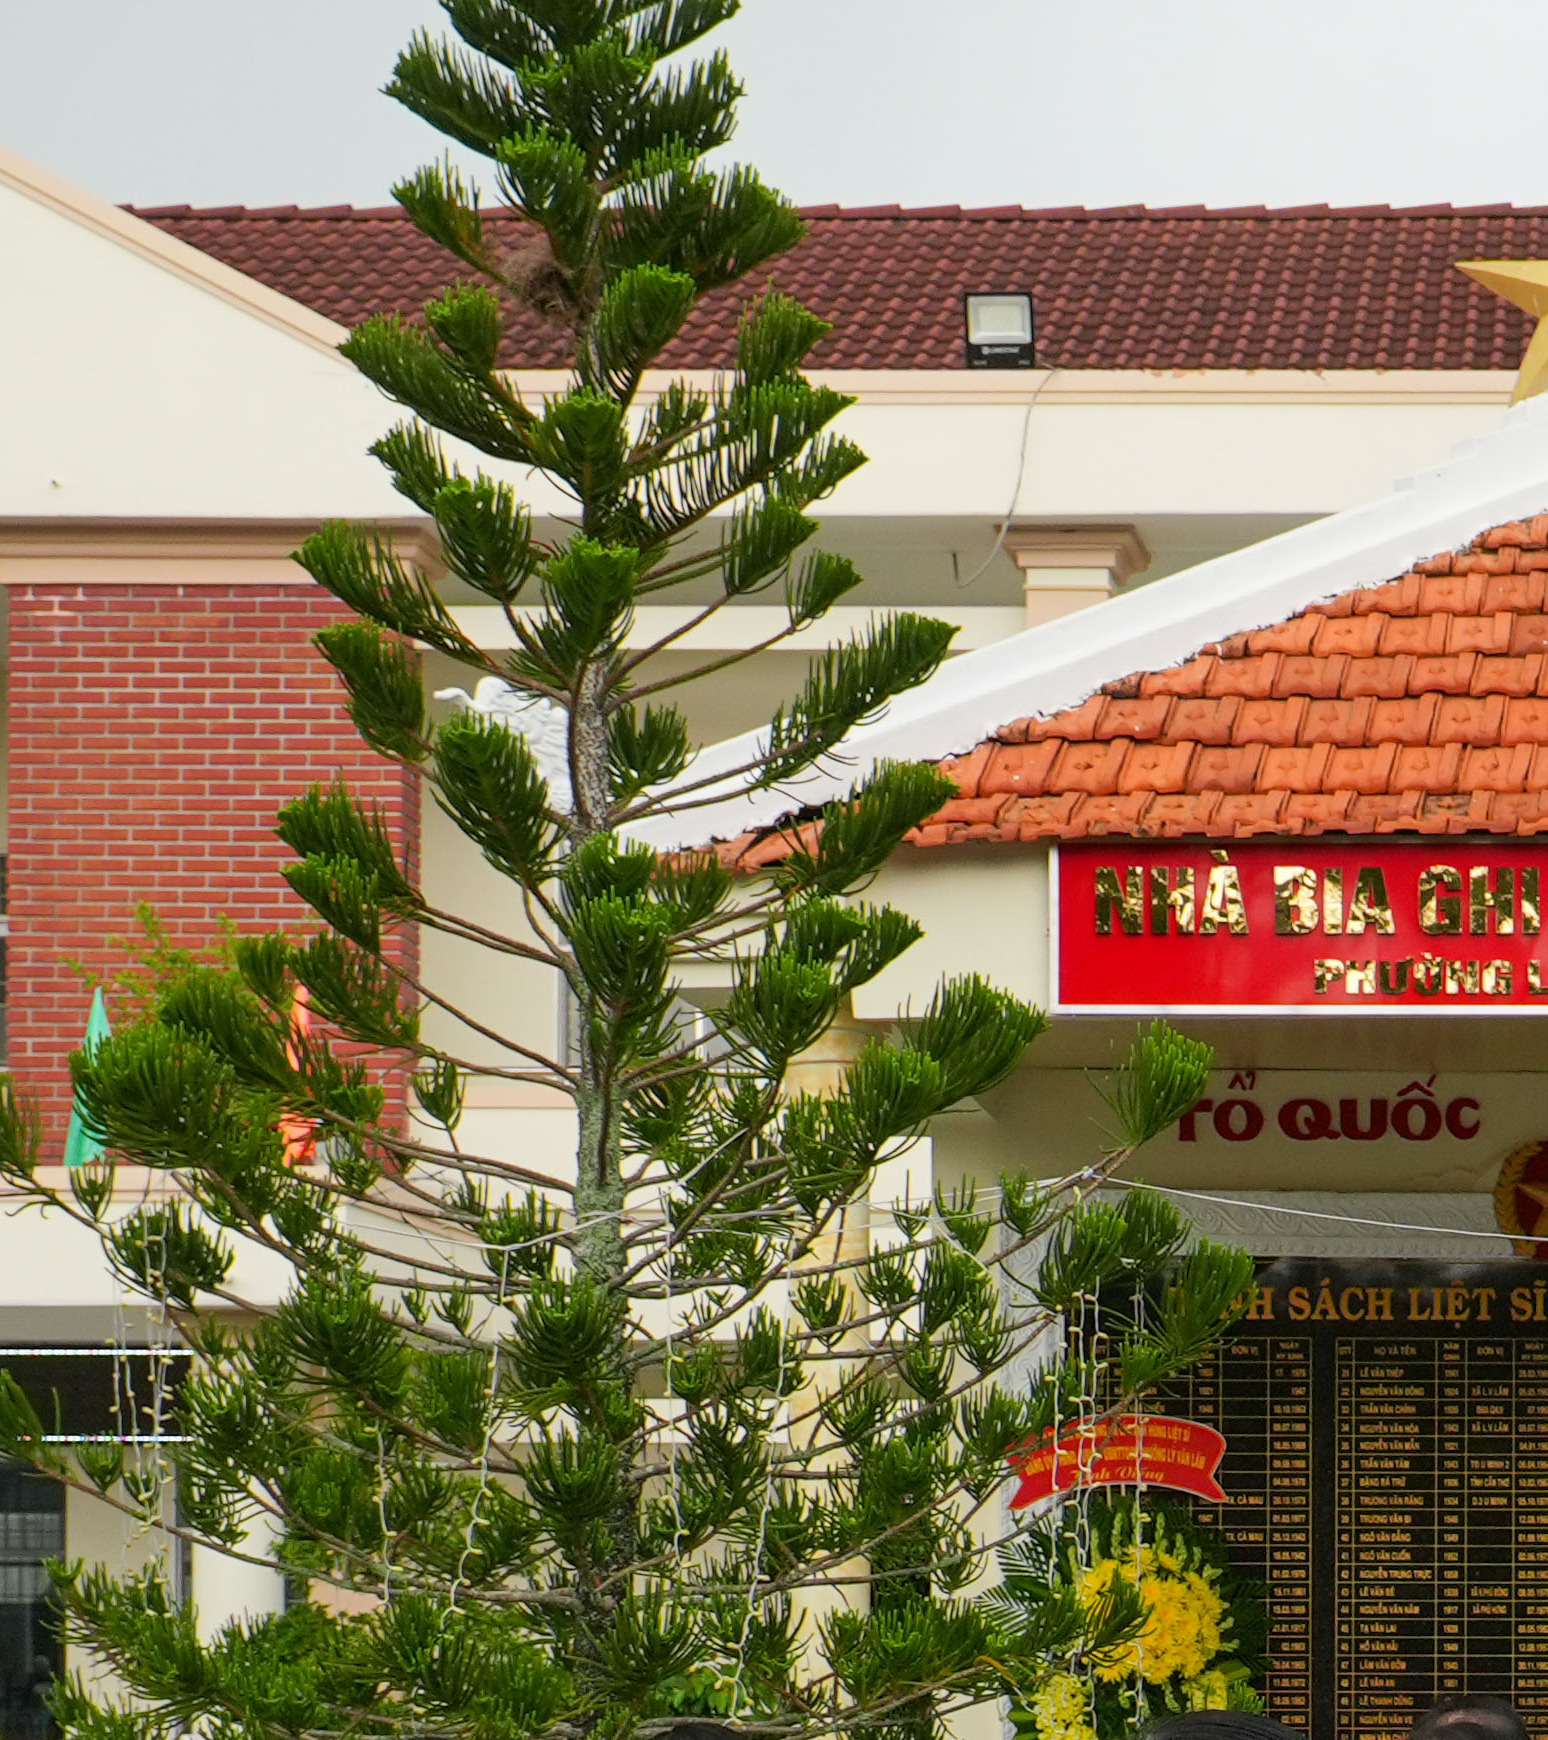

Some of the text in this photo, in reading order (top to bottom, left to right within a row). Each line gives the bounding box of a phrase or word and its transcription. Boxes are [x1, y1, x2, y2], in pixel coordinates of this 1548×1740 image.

[1094, 849, 1248, 935] NHÀ
[1272, 866, 1397, 935] BIA
[1419, 866, 1541, 935] GHI
[1314, 952, 1513, 996] PHƯỜNG
[1179, 1070, 1264, 1142] TỔ
[1279, 1071, 1481, 1142] QUỐC
[1289, 1278, 1394, 1322] SÁCH
[1408, 1281, 1495, 1328] LIỆT
[1511, 1280, 1546, 1321] SĨ
